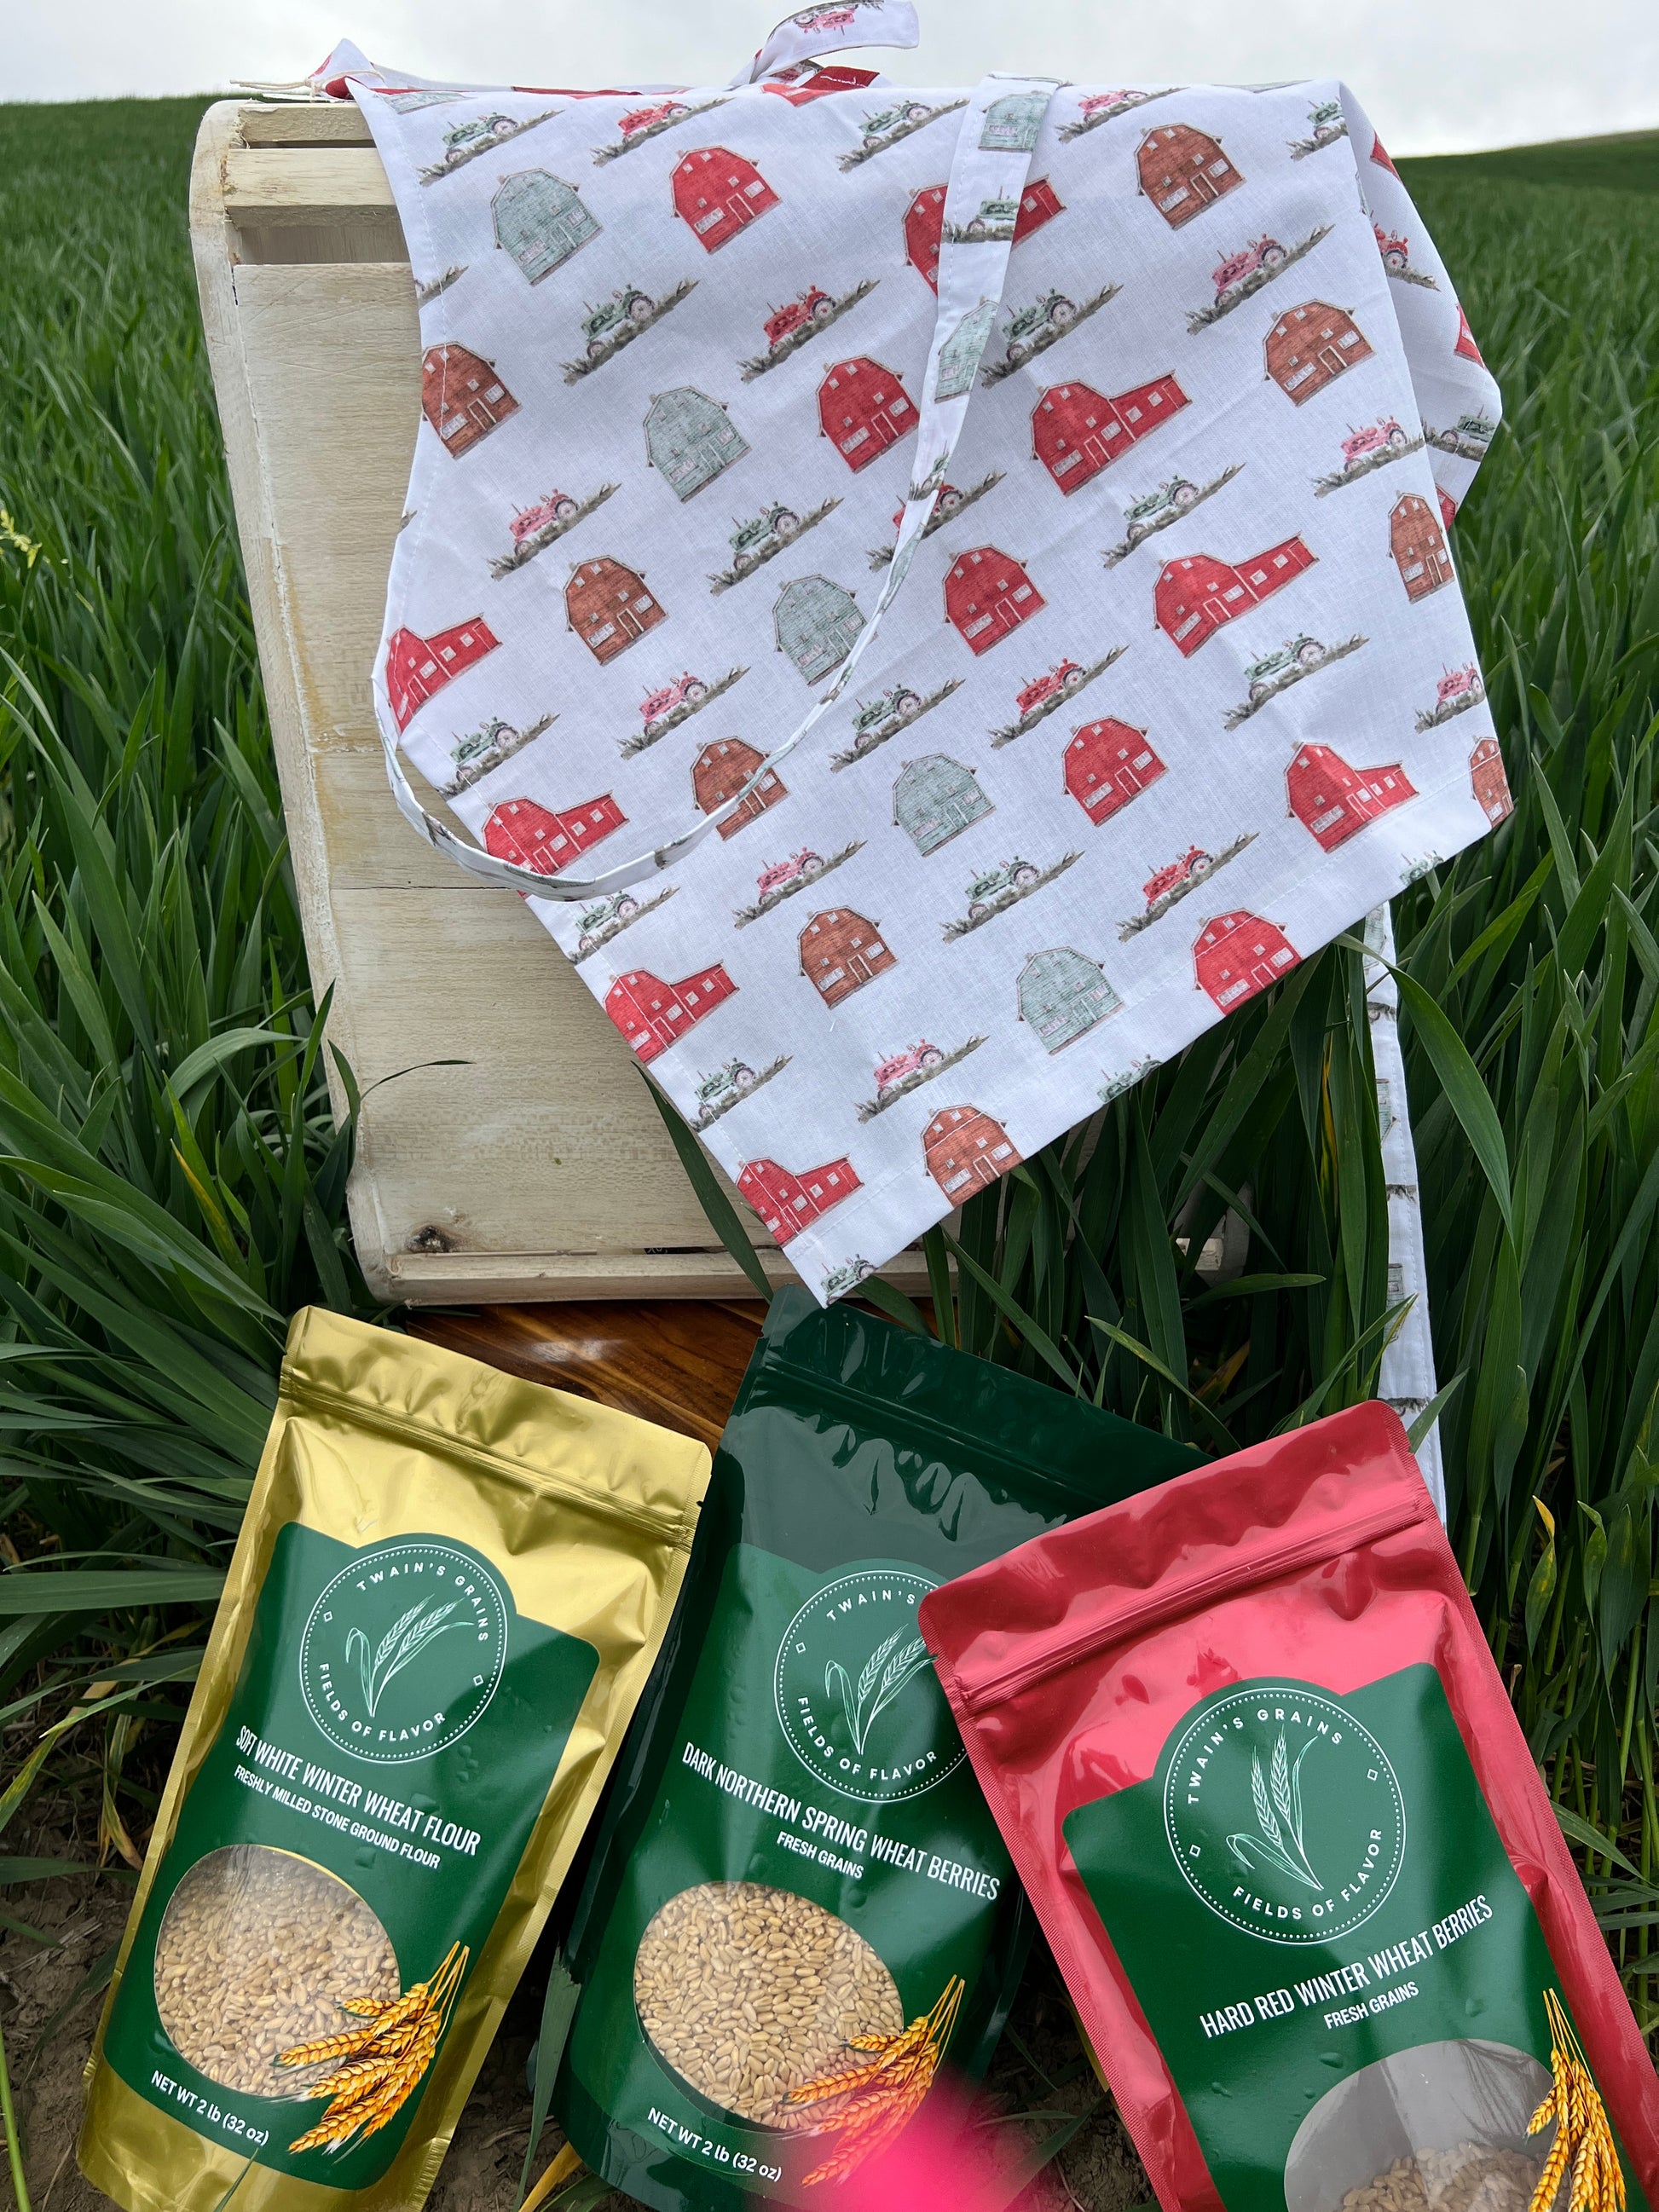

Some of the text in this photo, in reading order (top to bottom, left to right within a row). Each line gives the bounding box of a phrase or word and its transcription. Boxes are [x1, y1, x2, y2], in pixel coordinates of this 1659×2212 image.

[356, 1562, 488, 1642] TWAIN'S GRAINS
[827, 1590, 916, 1621] TWAIN'S
[320, 1663, 445, 1741] FIELDS OF FLAVOR
[797, 1696, 937, 1781] FIELDS OF FLAVOR
[235, 1724, 481, 1856] SOFT WHITE WINTER WHEAT FLOUR
[1188, 1708, 1343, 1804] TWAIN'S GRAINS
[234, 1764, 441, 1869] FRESHLY MILLED STONE GROUND FLOUR
[682, 1741, 1001, 1901] DARK NORTHERN SPRING WHEAT BERRIES
[777, 1831, 864, 1880] FRESH GRAINS
[1233, 1828, 1382, 1920] FIELDS OF FLAVOR
[1199, 1894, 1493, 2038] HARD RED WINTER WHEAT BERRIES
[1324, 1981, 1419, 2030] FRESH GRAINS
[151, 2070, 269, 2146] NET WT 2 lb (32 oz)
[648, 2107, 782, 2182] NET WT 2 lb (32 oz)
